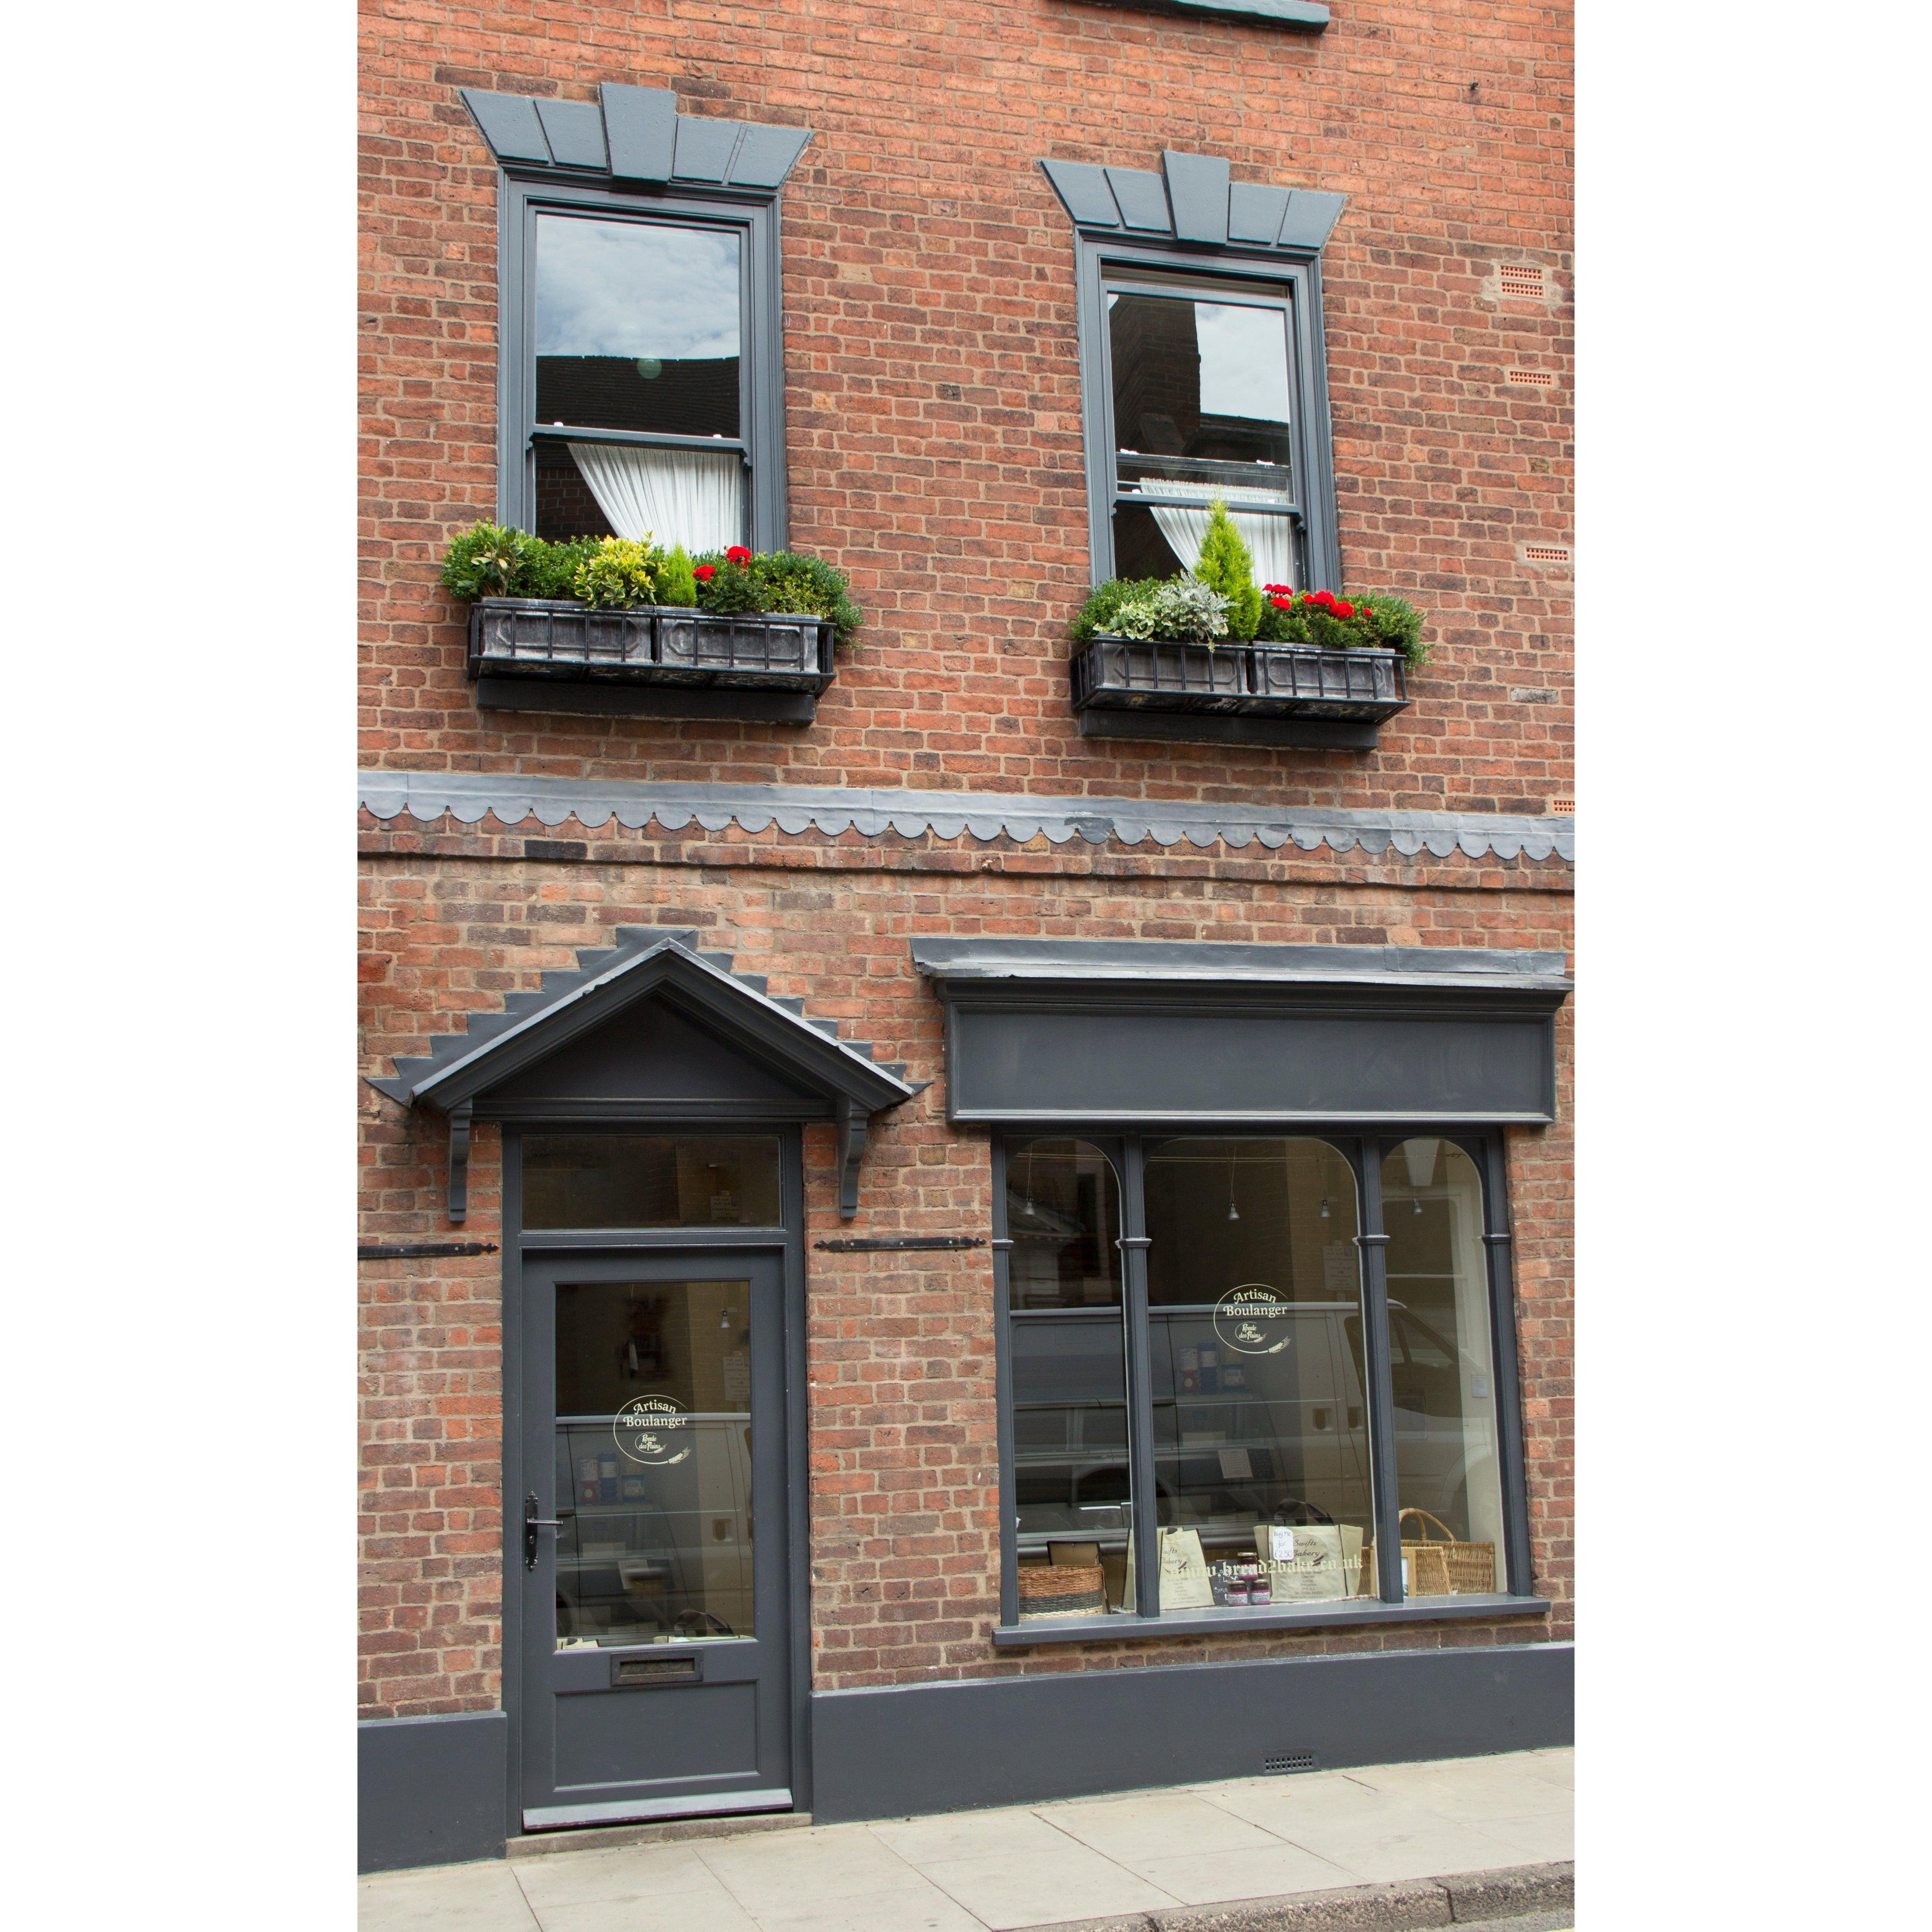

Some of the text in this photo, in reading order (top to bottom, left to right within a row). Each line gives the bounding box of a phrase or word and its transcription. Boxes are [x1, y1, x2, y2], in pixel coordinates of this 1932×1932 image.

[1233, 1289, 1276, 1304] Artisan
[1223, 1304, 1287, 1318] Boulanger
[1242, 1323, 1257, 1333] Ronde
[1247, 1331, 1260, 1340] Pains
[633, 1400, 676, 1415] Artisan
[623, 1415, 687, 1429] Boulanger
[642, 1434, 657, 1443] Ronde
[647, 1441, 660, 1450] Pains
[1293, 1539, 1317, 1548] Swifts
